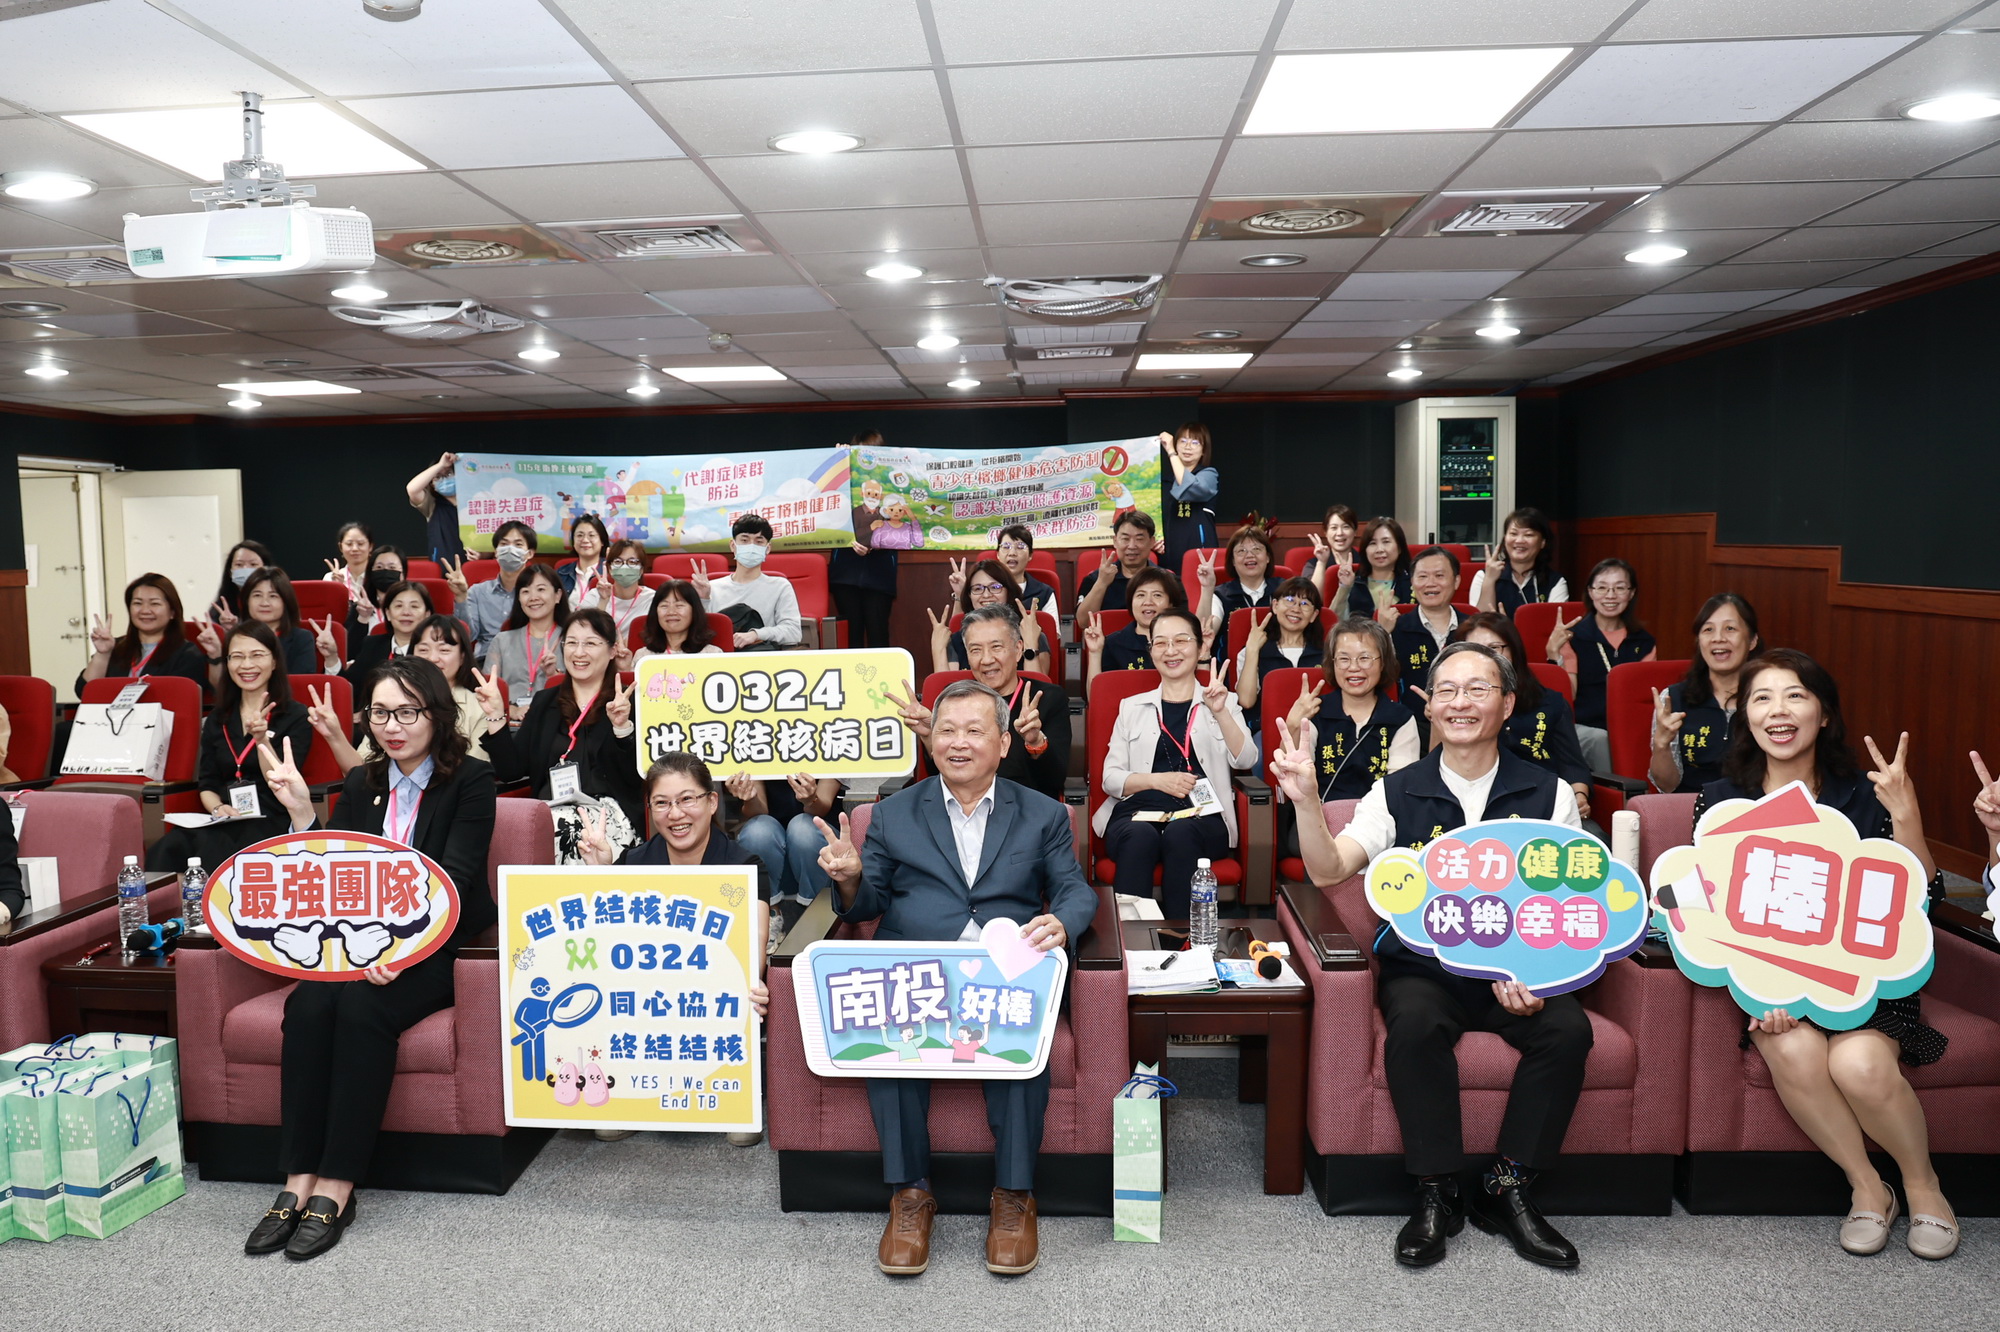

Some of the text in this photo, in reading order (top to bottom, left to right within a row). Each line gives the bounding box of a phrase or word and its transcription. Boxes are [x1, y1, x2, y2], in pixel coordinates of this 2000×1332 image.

[684, 460, 765, 487] 代謝症候群
[930, 450, 1101, 490] 青少年檳榔健康危害防制
[467, 496, 544, 516] 認識失智症
[707, 484, 740, 502] 防治
[954, 483, 1094, 518] 認識失智症照護資源
[476, 515, 536, 534] 照護源
[701, 668, 845, 714] 0324
[646, 717, 904, 764] 世界結核病日
[1436, 843, 1603, 881] 活力 健康
[238, 858, 422, 921] 最強團隊
[525, 893, 731, 941] 世界結核病日
[1427, 899, 1601, 939] 快樂 幸福
[610, 943, 709, 970] 0324
[609, 990, 740, 1018] 同心協力
[825, 958, 1036, 1035] 南投 好棒
[609, 1032, 746, 1062] 終結結核
[630, 1075, 659, 1089] YES
[683, 1075, 704, 1090] We
[712, 1078, 740, 1091] can
[661, 1094, 717, 1109] End TB
